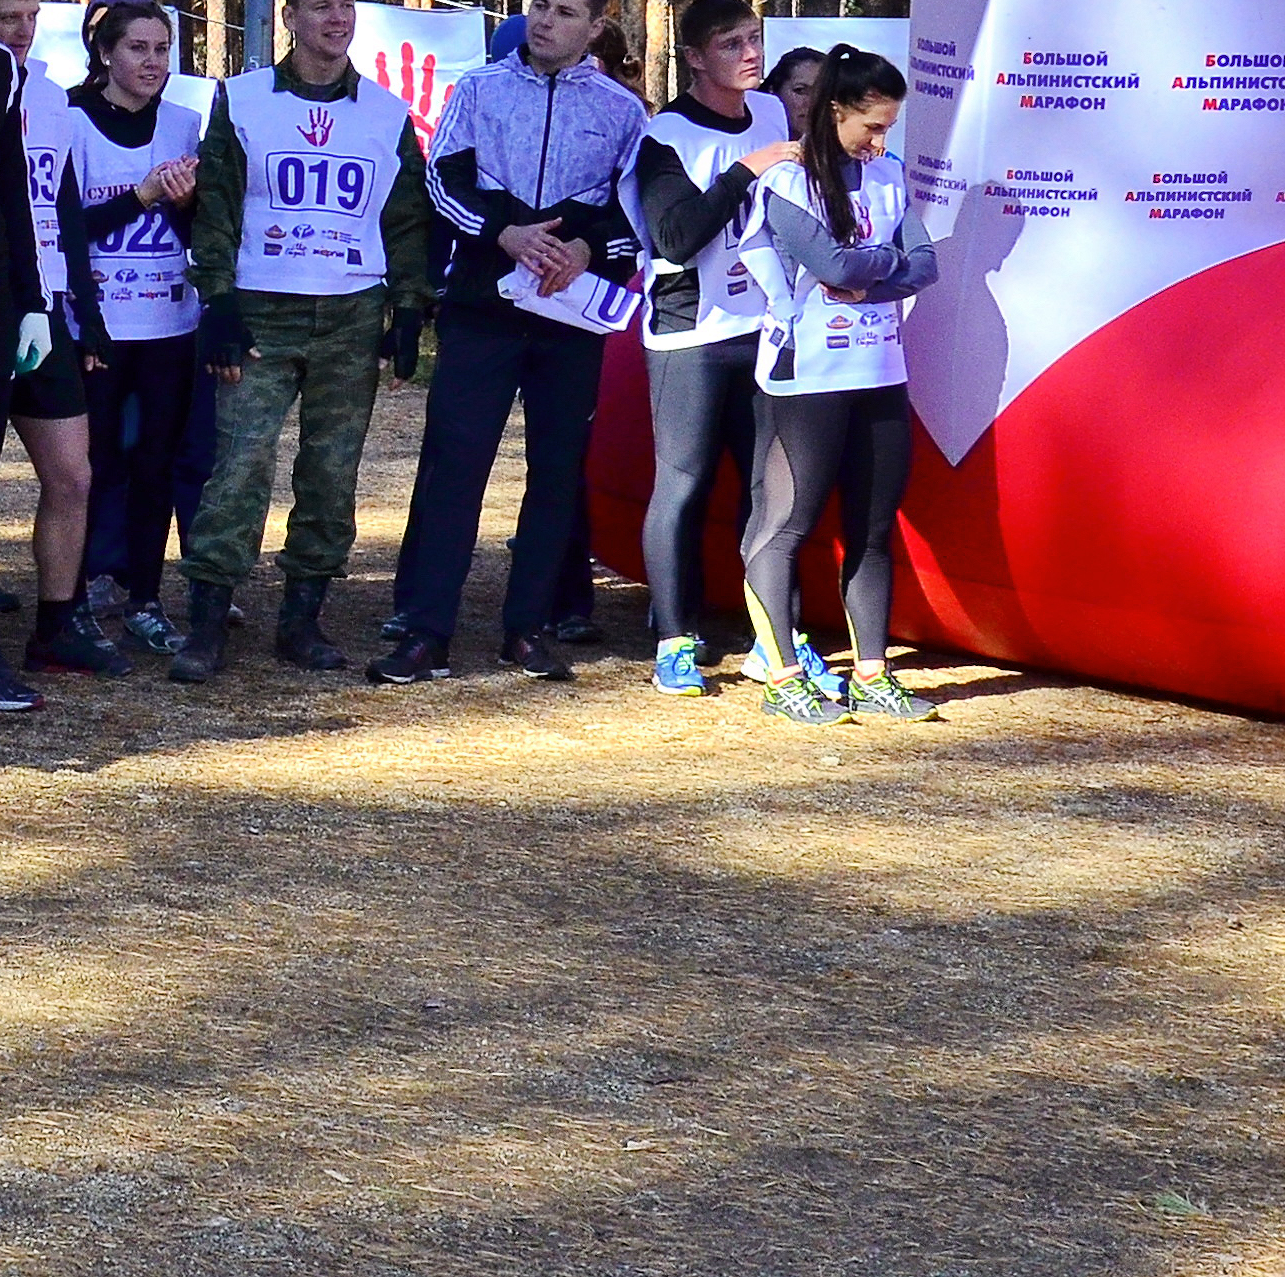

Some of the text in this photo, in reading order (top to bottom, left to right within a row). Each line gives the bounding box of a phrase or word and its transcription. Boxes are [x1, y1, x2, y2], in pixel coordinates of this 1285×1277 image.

[1024, 51, 1108, 66] БОЛЬШОЙ
[1205, 54, 1285, 68] БОЛЬШО
[996, 72, 1140, 88] АЛЬПИНИСТСКИЙ
[1020, 95, 1106, 110] МАРАФОН
[1007, 170, 1074, 182] БОЛЬШОЙ
[1153, 171, 1228, 184] БОЛЬШОЙ
[278, 157, 364, 210] 019
[984, 186, 1098, 200] АЛЬПИНИСТСКИЙ
[1125, 189, 1252, 202] АЛЬПИНИСТСКИЙ
[1002, 204, 1070, 217] МАРАФОН
[1149, 208, 1225, 219] МАРАФОН
